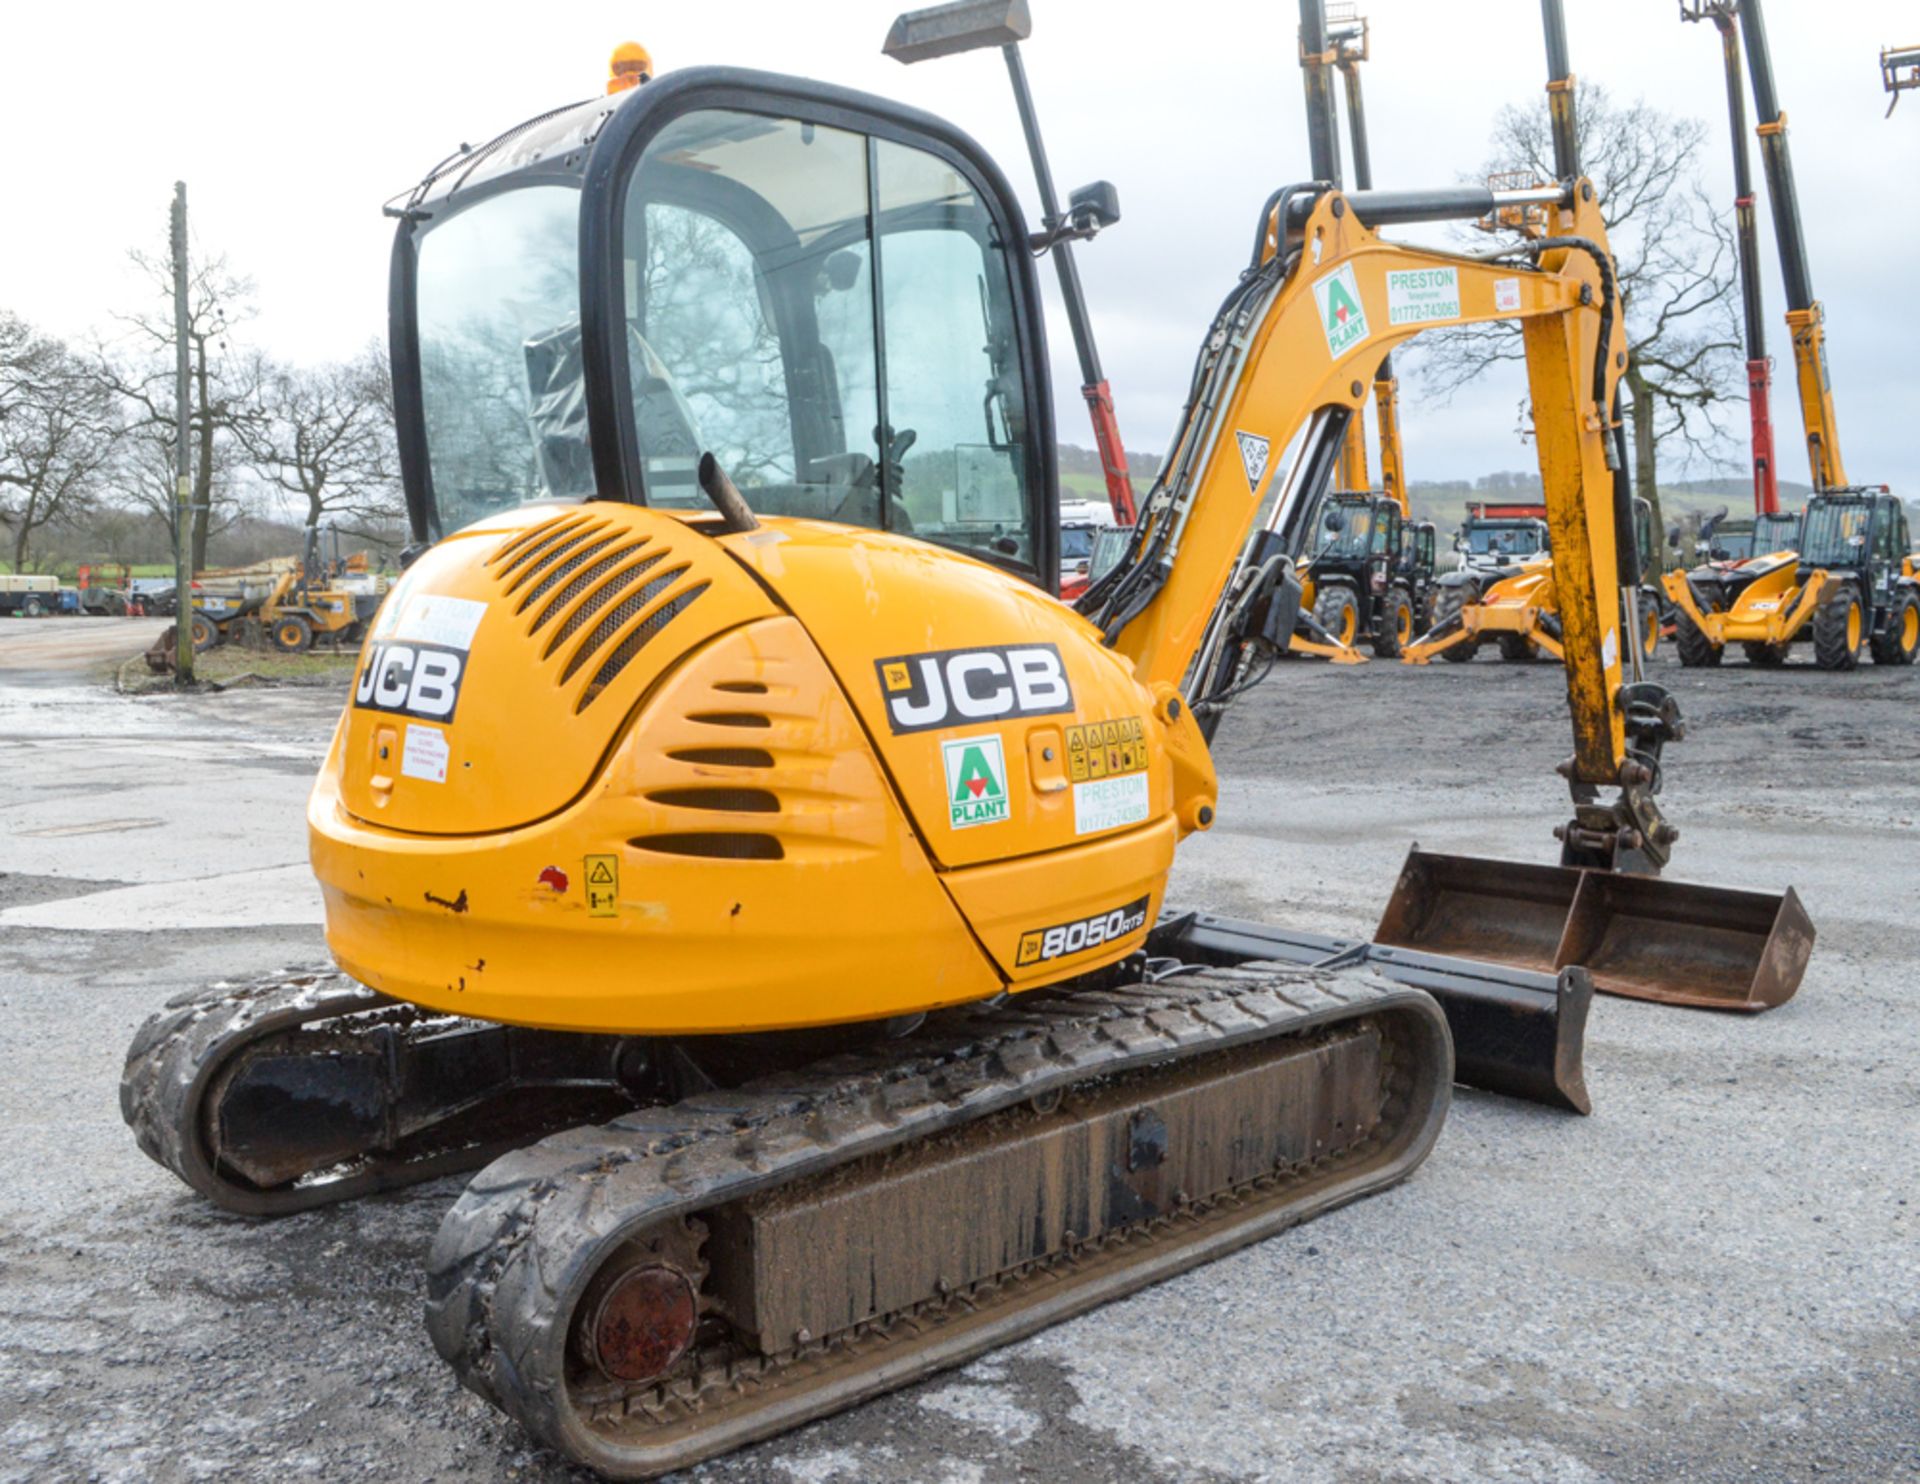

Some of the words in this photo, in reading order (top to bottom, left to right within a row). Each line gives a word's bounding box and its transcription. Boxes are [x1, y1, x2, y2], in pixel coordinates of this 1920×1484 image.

[1391, 270, 1453, 290] PRESTON
[1329, 317, 1366, 352] PLANT
[356, 646, 461, 716] JCB
[890, 648, 1069, 726] JCB
[1081, 776, 1143, 804] PRESTON
[952, 799, 1008, 824] PLANT
